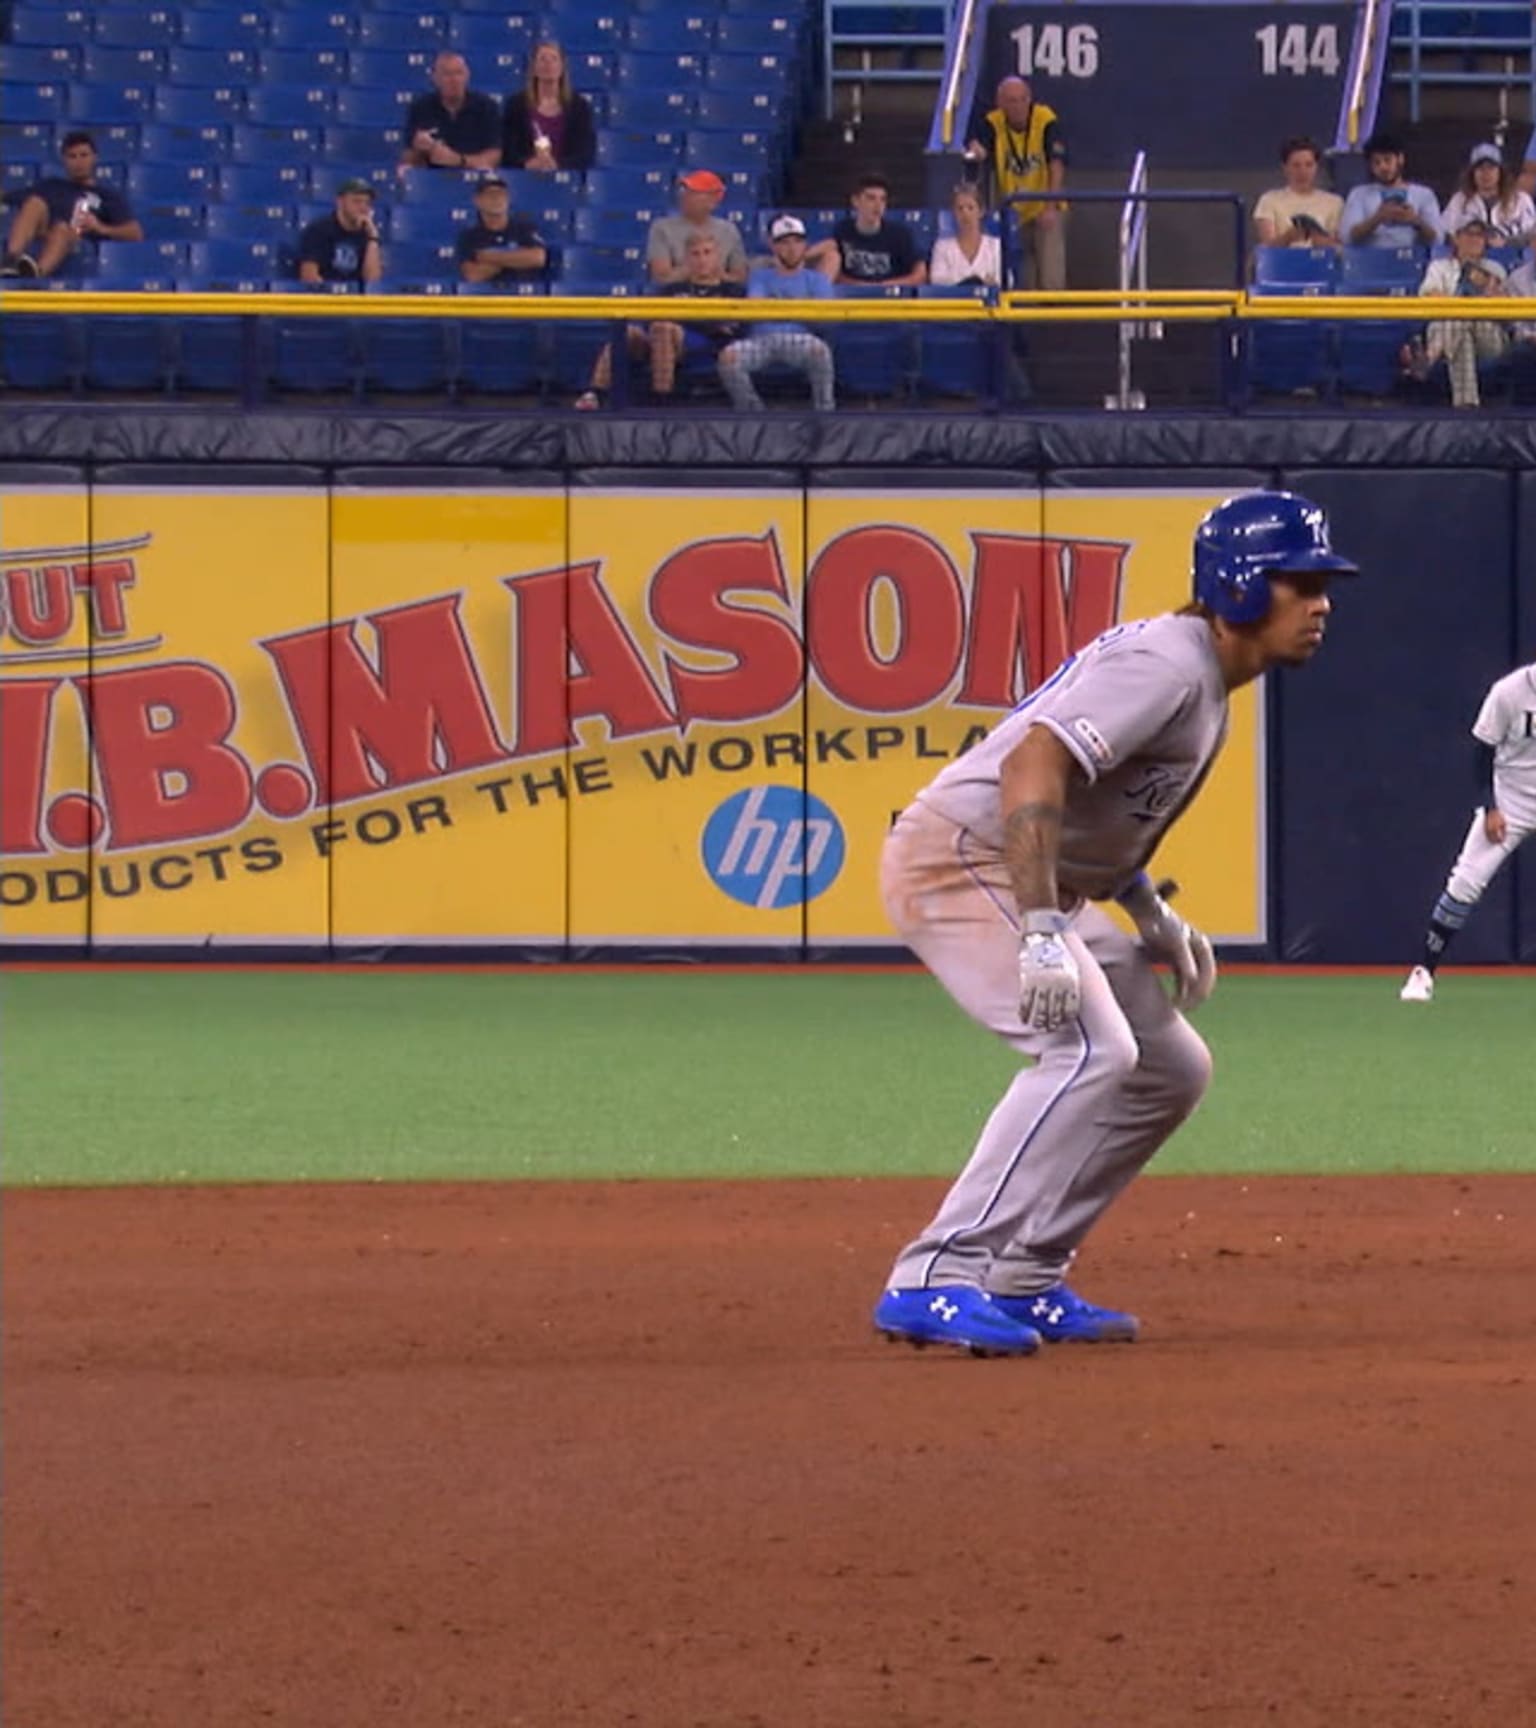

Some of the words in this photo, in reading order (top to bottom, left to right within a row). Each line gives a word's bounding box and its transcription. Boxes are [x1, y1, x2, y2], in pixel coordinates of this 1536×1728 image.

[1011, 23, 1099, 76] 146
[1256, 24, 1341, 76] 144
[0, 558, 135, 642] UT
[311, 795, 454, 857] FOR
[477, 758, 614, 813] THE
[716, 785, 836, 909] hp
